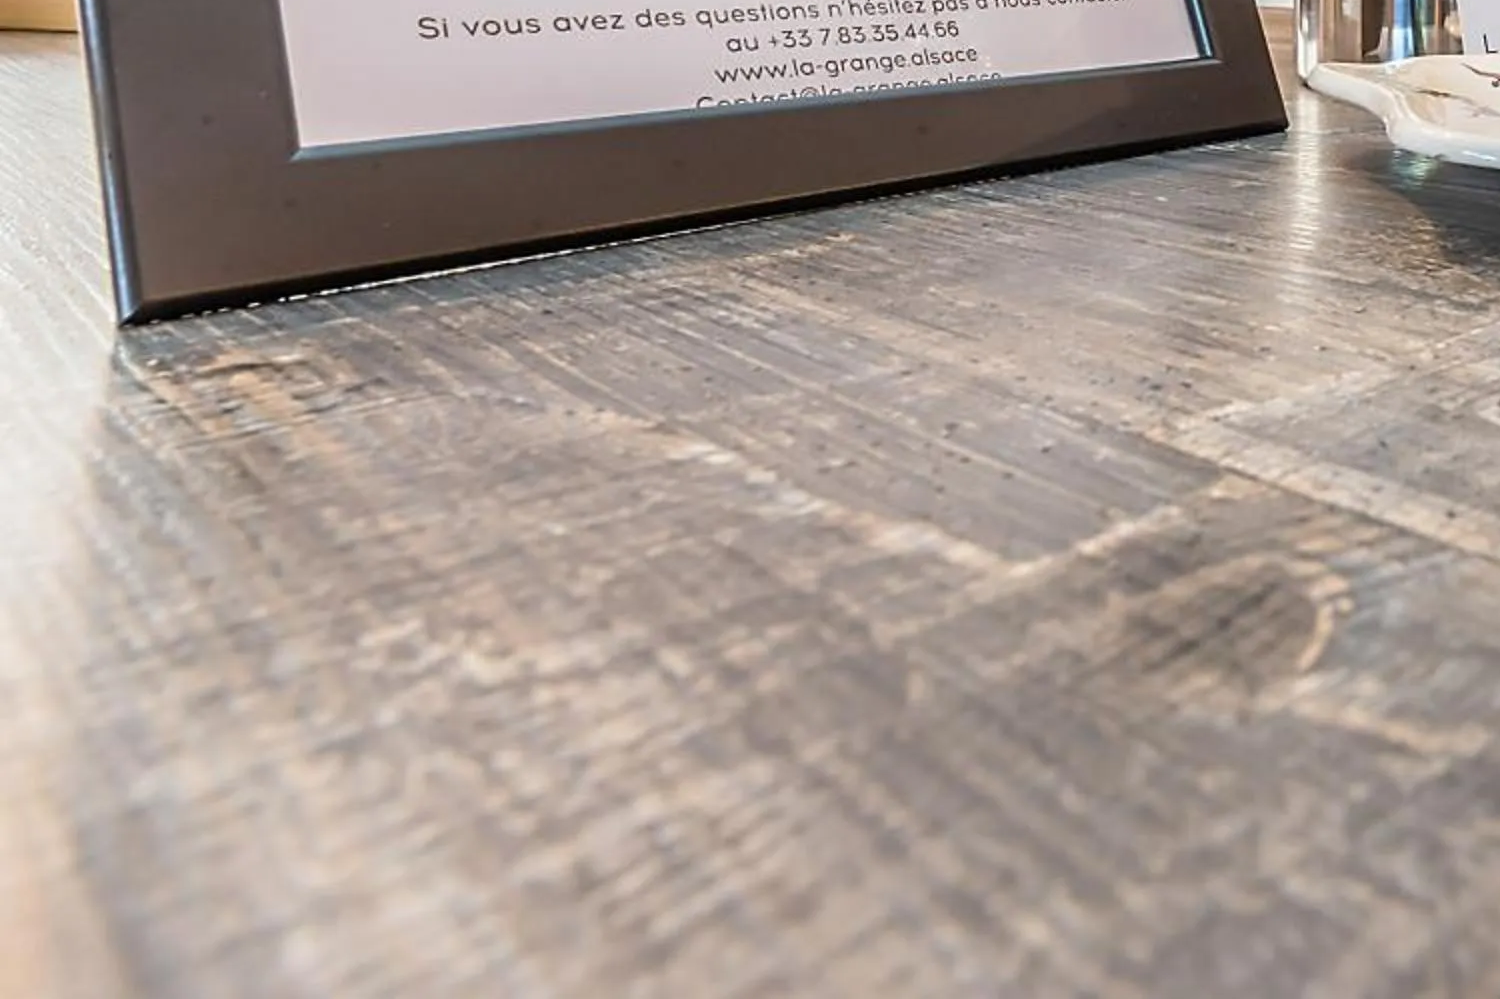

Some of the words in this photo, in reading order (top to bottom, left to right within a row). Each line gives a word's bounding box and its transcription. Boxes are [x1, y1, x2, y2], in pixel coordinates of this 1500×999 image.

[417, 16, 449, 39] Si
[461, 17, 541, 36] vous
[553, 13, 625, 33] avez
[635, 8, 686, 28] des
[695, 3, 820, 29] questions
[726, 36, 759, 52] au
[769, 28, 813, 48] +33
[714, 46, 978, 83] www.la-grange.alsace
